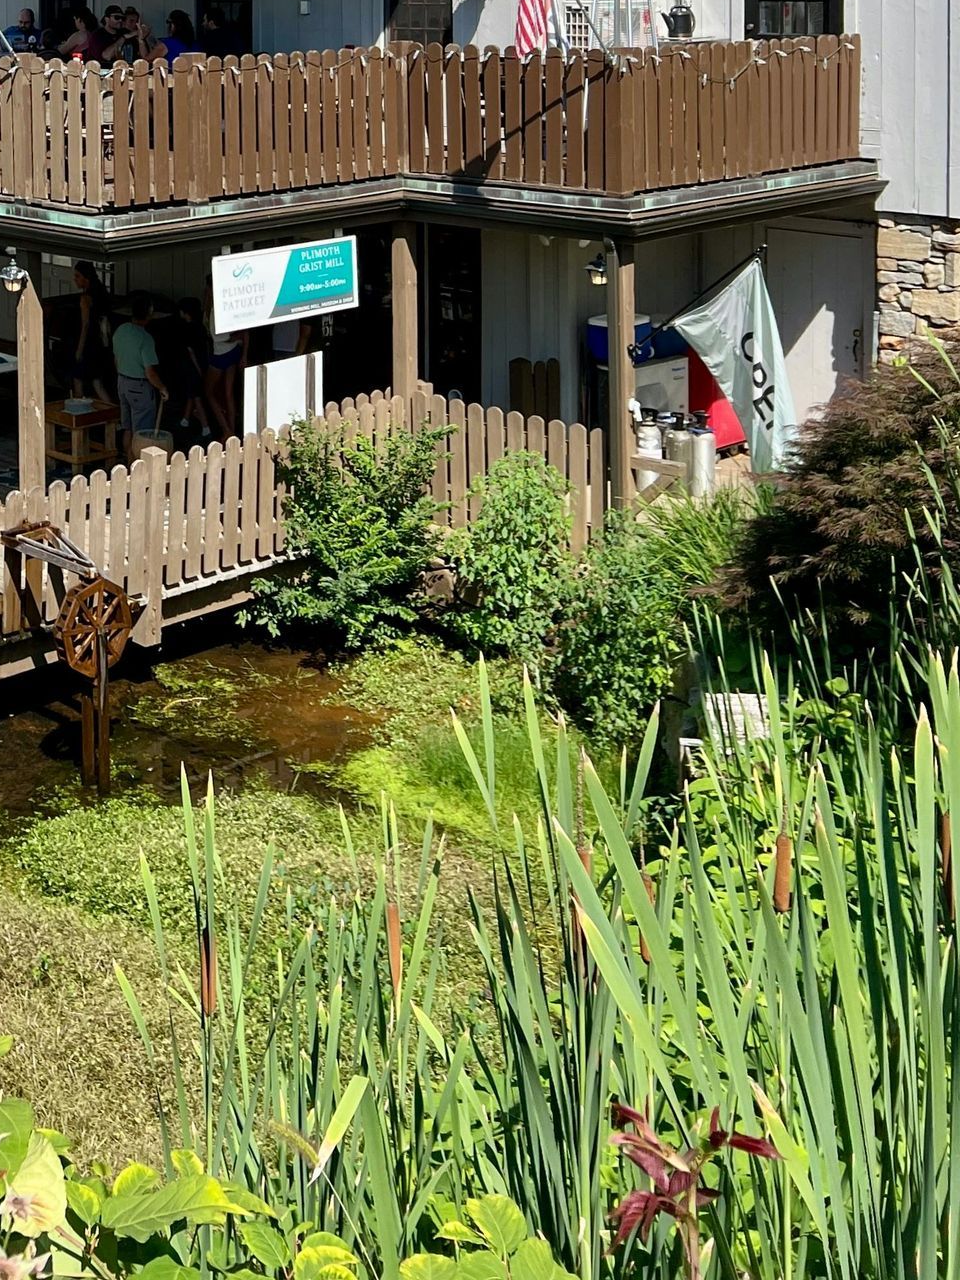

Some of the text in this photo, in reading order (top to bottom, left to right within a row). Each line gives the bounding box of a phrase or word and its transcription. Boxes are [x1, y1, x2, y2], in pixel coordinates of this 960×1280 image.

[301, 246, 340, 260] PLIMOTH
[299, 257, 344, 273] GRIST MILL
[223, 281, 265, 298] PLIMOTH
[222, 295, 265, 311] PATUXET
